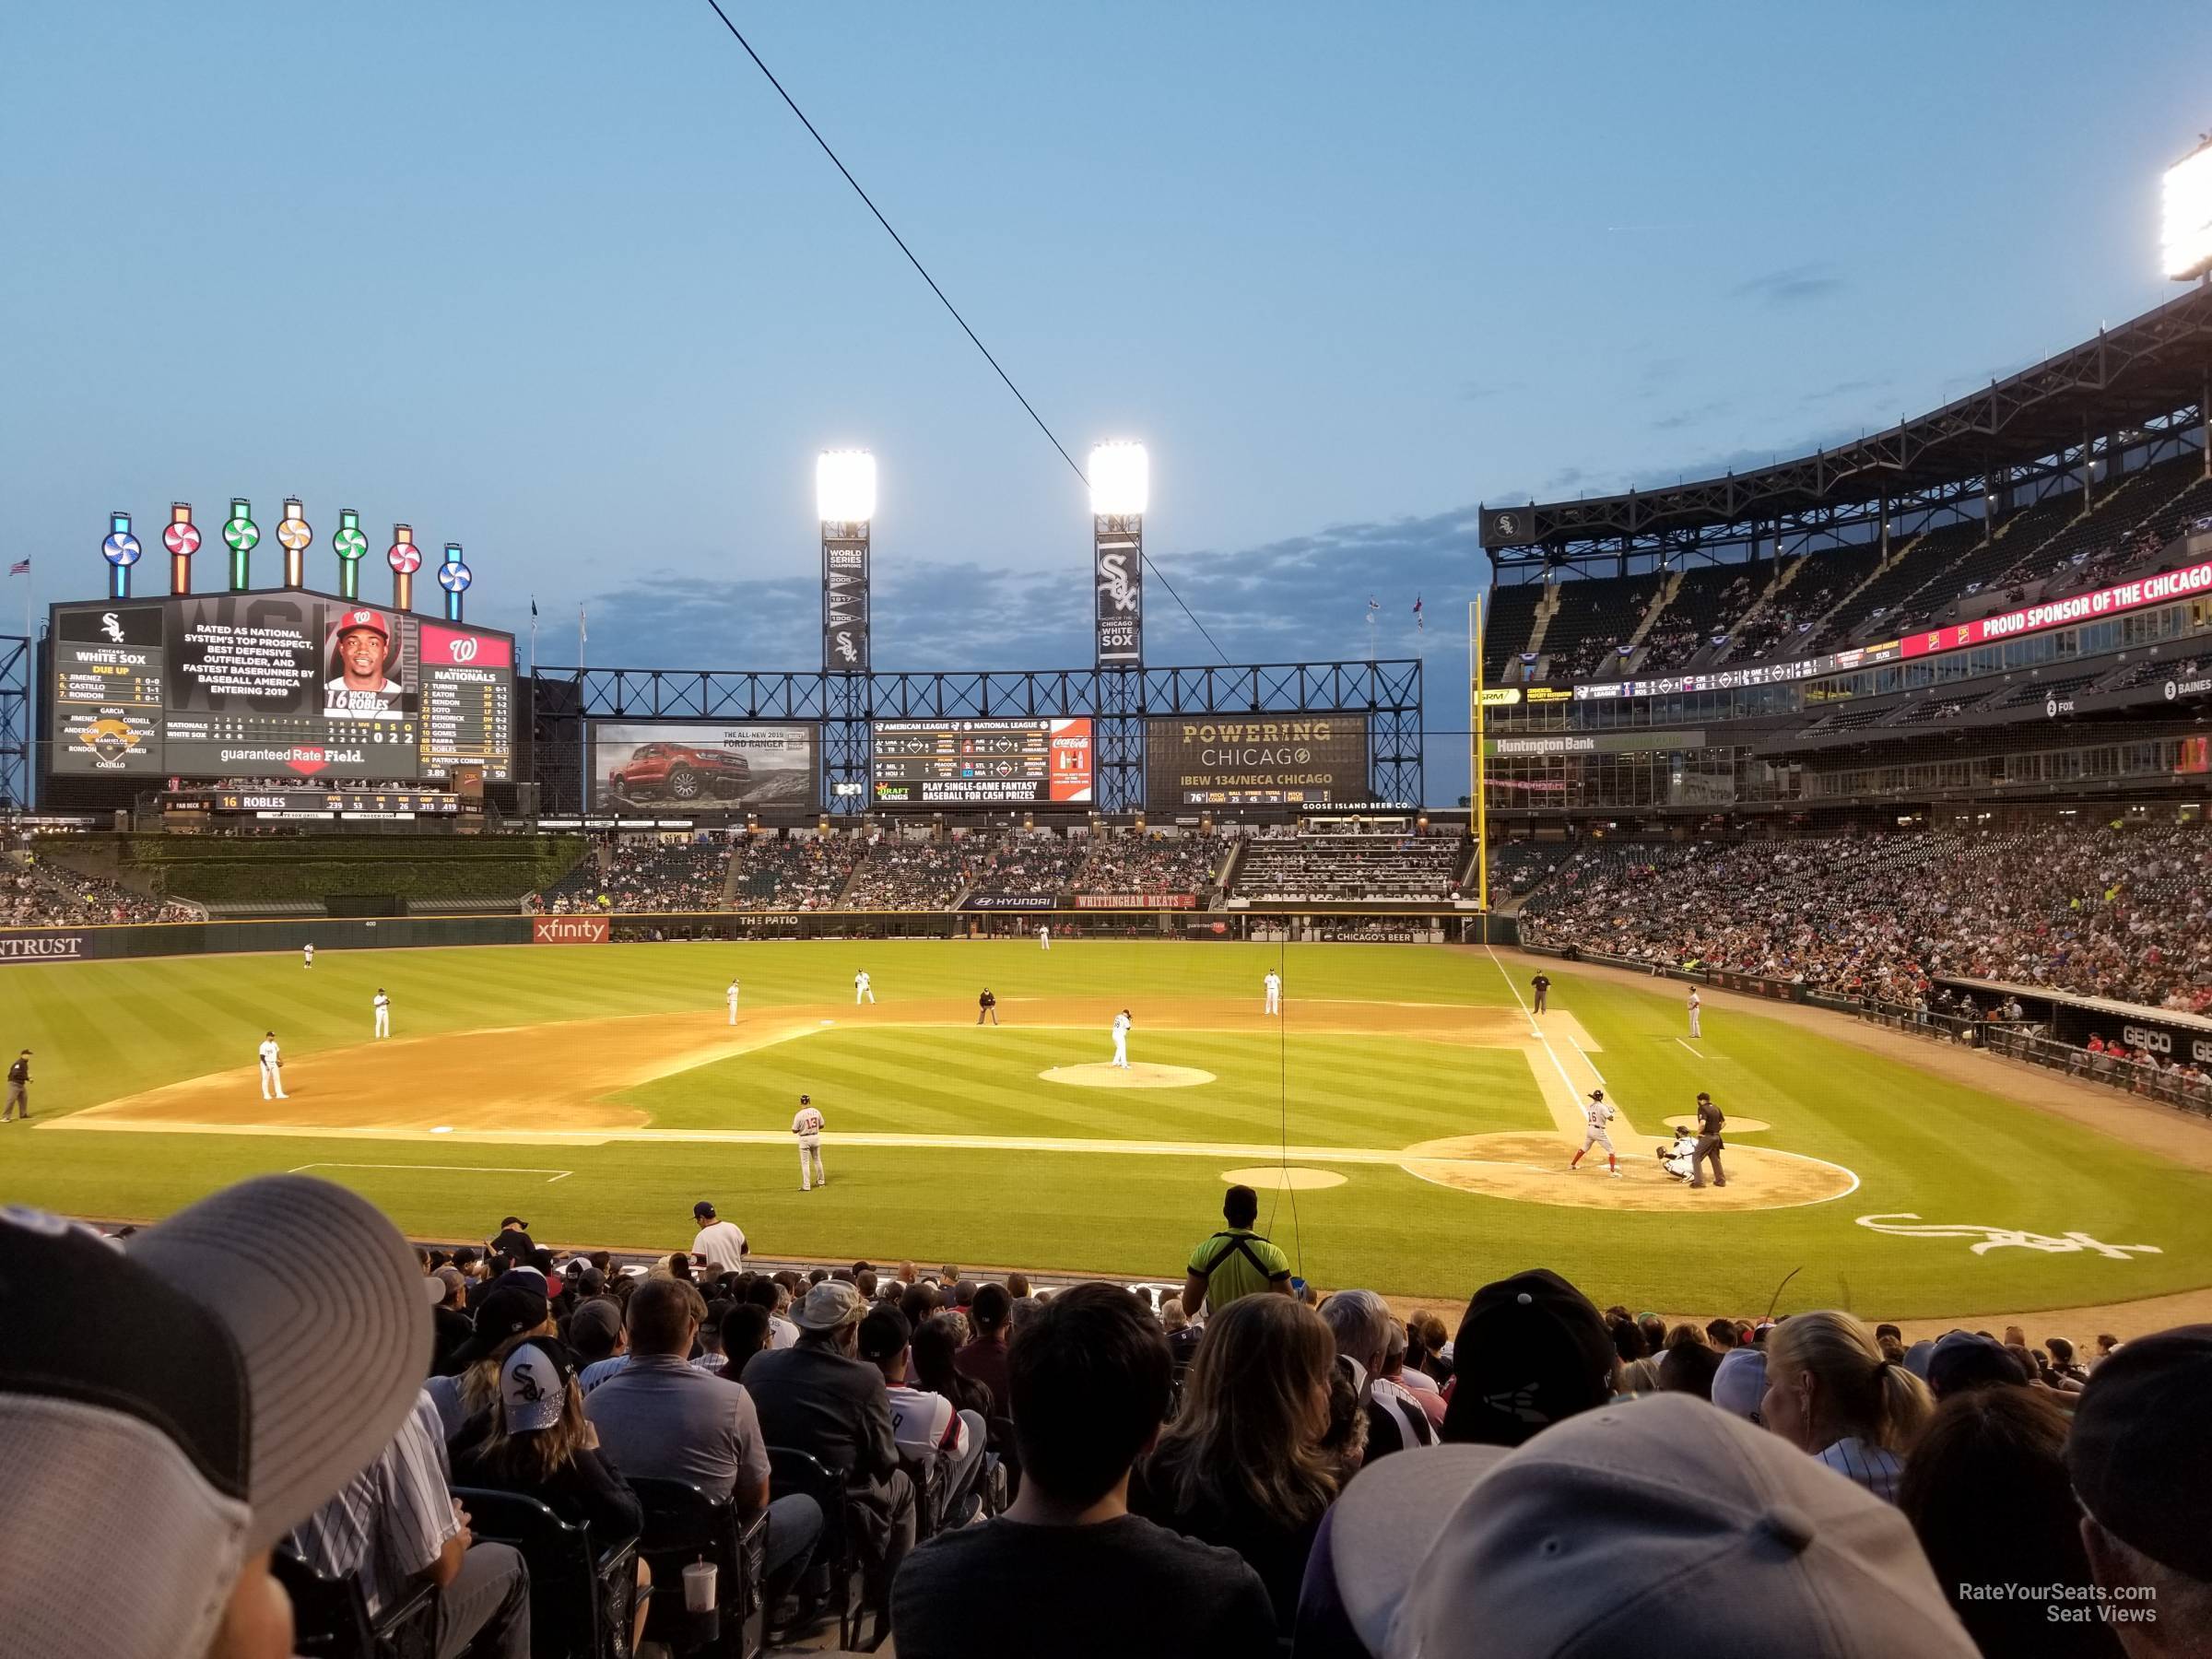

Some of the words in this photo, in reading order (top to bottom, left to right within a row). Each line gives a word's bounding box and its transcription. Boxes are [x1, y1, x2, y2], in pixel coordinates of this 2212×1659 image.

[1983, 615, 2024, 637] PROUD
[2028, 596, 2090, 627] SPONSOR
[2093, 593, 2111, 612] OF
[2113, 584, 2140, 606] THE
[2144, 565, 2212, 599] CHICAGO
[197, 625, 231, 634] RATED
[251, 629, 302, 638] NATIONAL
[184, 634, 233, 643] SYSTEM'S
[236, 637, 256, 645] TOP
[259, 639, 313, 650] PROSPECT,
[1102, 635, 1133, 646] SOX
[76, 652, 116, 663] WHITE
[120, 654, 146, 664] SOX
[236, 647, 291, 657] DEFENSIVE
[204, 655, 270, 666] OUTFIELDER,
[182, 665, 228, 673] FASTEST
[230, 667, 299, 677] BASERUNNER
[435, 672, 496, 682] NATIONALS
[198, 675, 252, 684] BASEBALL
[254, 678, 300, 687] AMERICA
[2178, 679, 2211, 694] BAINES
[210, 686, 263, 695] ENTERING
[327, 690, 347, 708] 16
[348, 700, 389, 710] ROBLES
[2058, 700, 2074, 712] FOX
[374, 733, 383, 743] 0
[390, 734, 398, 743] 2
[405, 734, 413, 744] 2
[1183, 723, 1331, 743] POWERING
[1497, 739, 1563, 754] Huntington
[1565, 737, 1594, 750] Bank
[221, 749, 290, 761] guaranteed
[293, 749, 321, 760] Rate
[324, 750, 365, 762] Field.
[1202, 748, 1311, 767] CHICAGO
[1180, 776, 1211, 785] IBEW
[1215, 775, 1274, 785] 134/NECA
[1277, 774, 1333, 784] CHICAGO
[923, 782, 946, 791] PLAY
[947, 782, 999, 791] SINGLE-GAME
[1002, 782, 1037, 790] FANTASY
[223, 796, 237, 806] 16
[243, 797, 286, 807] ROBLES
[923, 792, 963, 800] BASEBALL
[1078, 896, 1144, 907] WHITTINGHAM
[1148, 896, 1179, 907] MEATS
[740, 916, 763, 924] THE
[765, 915, 798, 924] PATIO
[536, 918, 605, 942] xfinity
[1337, 933, 1386, 942] CHICAGO'S
[1388, 933, 1411, 942] BEER
[2124, 1025, 2171, 1053] GEICO
[806, 1117, 818, 1130] 13
